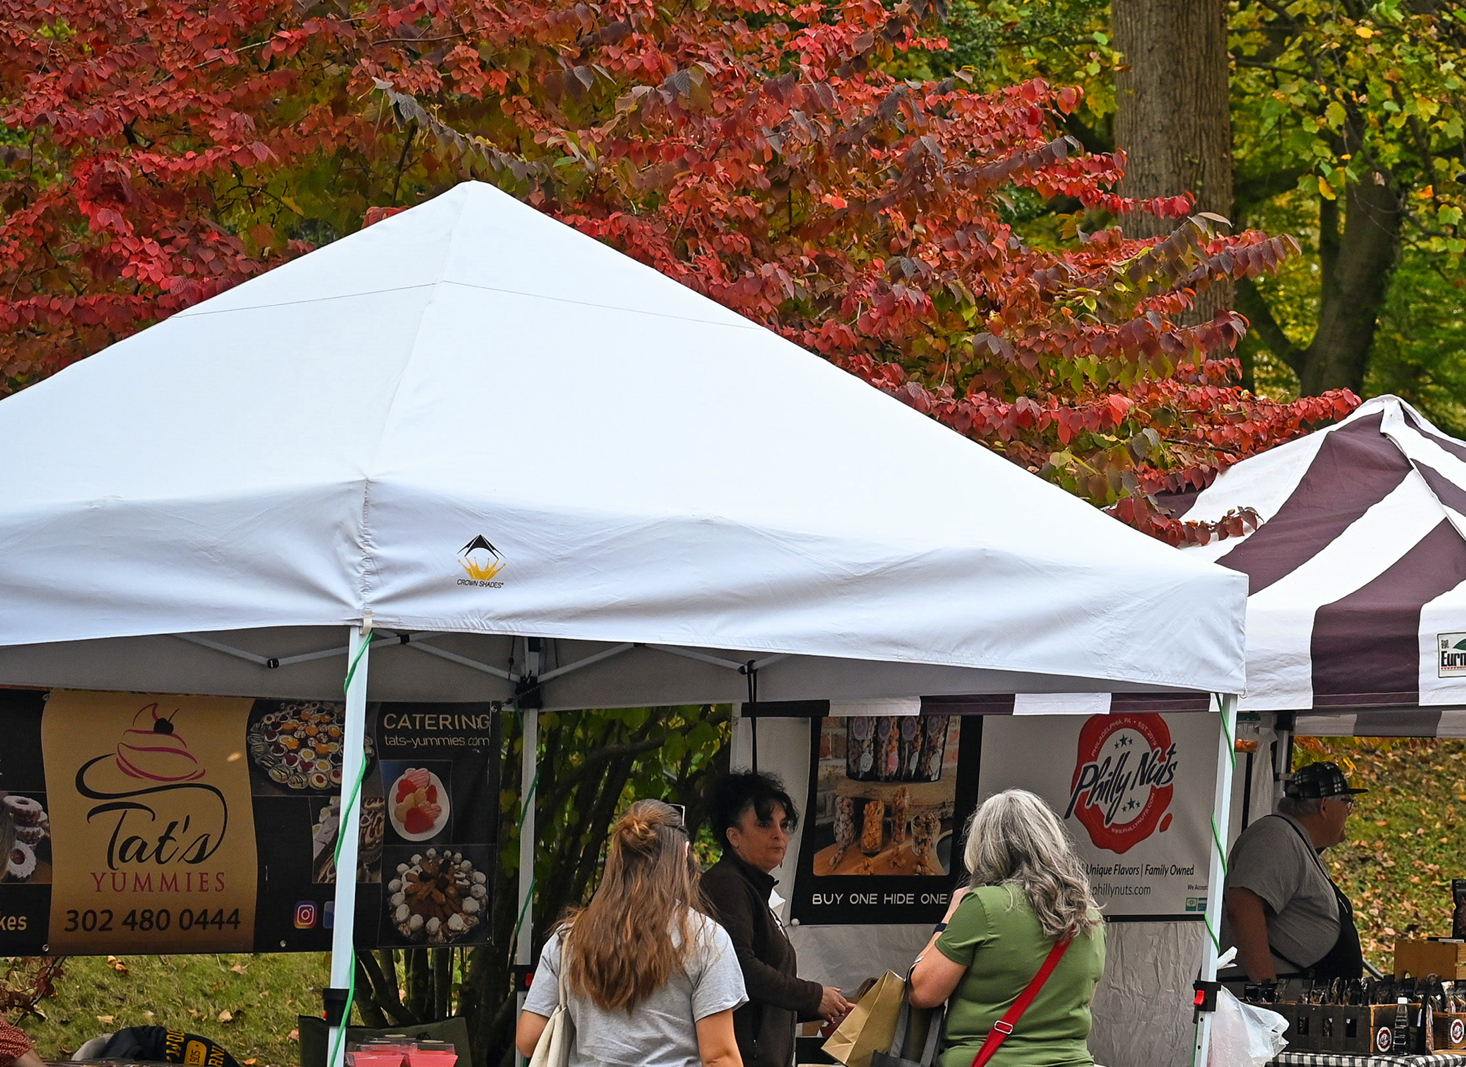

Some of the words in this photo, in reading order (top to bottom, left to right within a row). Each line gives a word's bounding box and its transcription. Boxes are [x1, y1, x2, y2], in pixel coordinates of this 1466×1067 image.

[456, 578, 478, 587] CROWN
[383, 713, 491, 730] CATERING
[384, 734, 490, 749] tats-yummies.com
[1063, 750, 1132, 826] Philly
[1130, 742, 1178, 791] Nuts
[87, 801, 214, 871] Tat's
[1085, 863, 1112, 877] Unique
[1113, 863, 1140, 876] Flavors
[1144, 864, 1168, 878] Family
[1169, 864, 1195, 876] Owned
[90, 871, 226, 893] YUMMIES
[812, 893, 844, 905] BUY
[849, 893, 878, 905] ONE
[883, 893, 915, 905] HIDE
[920, 893, 948, 905] ONE
[63, 908, 114, 932] 302
[121, 908, 171, 932] 480
[178, 908, 241, 931] 0444
